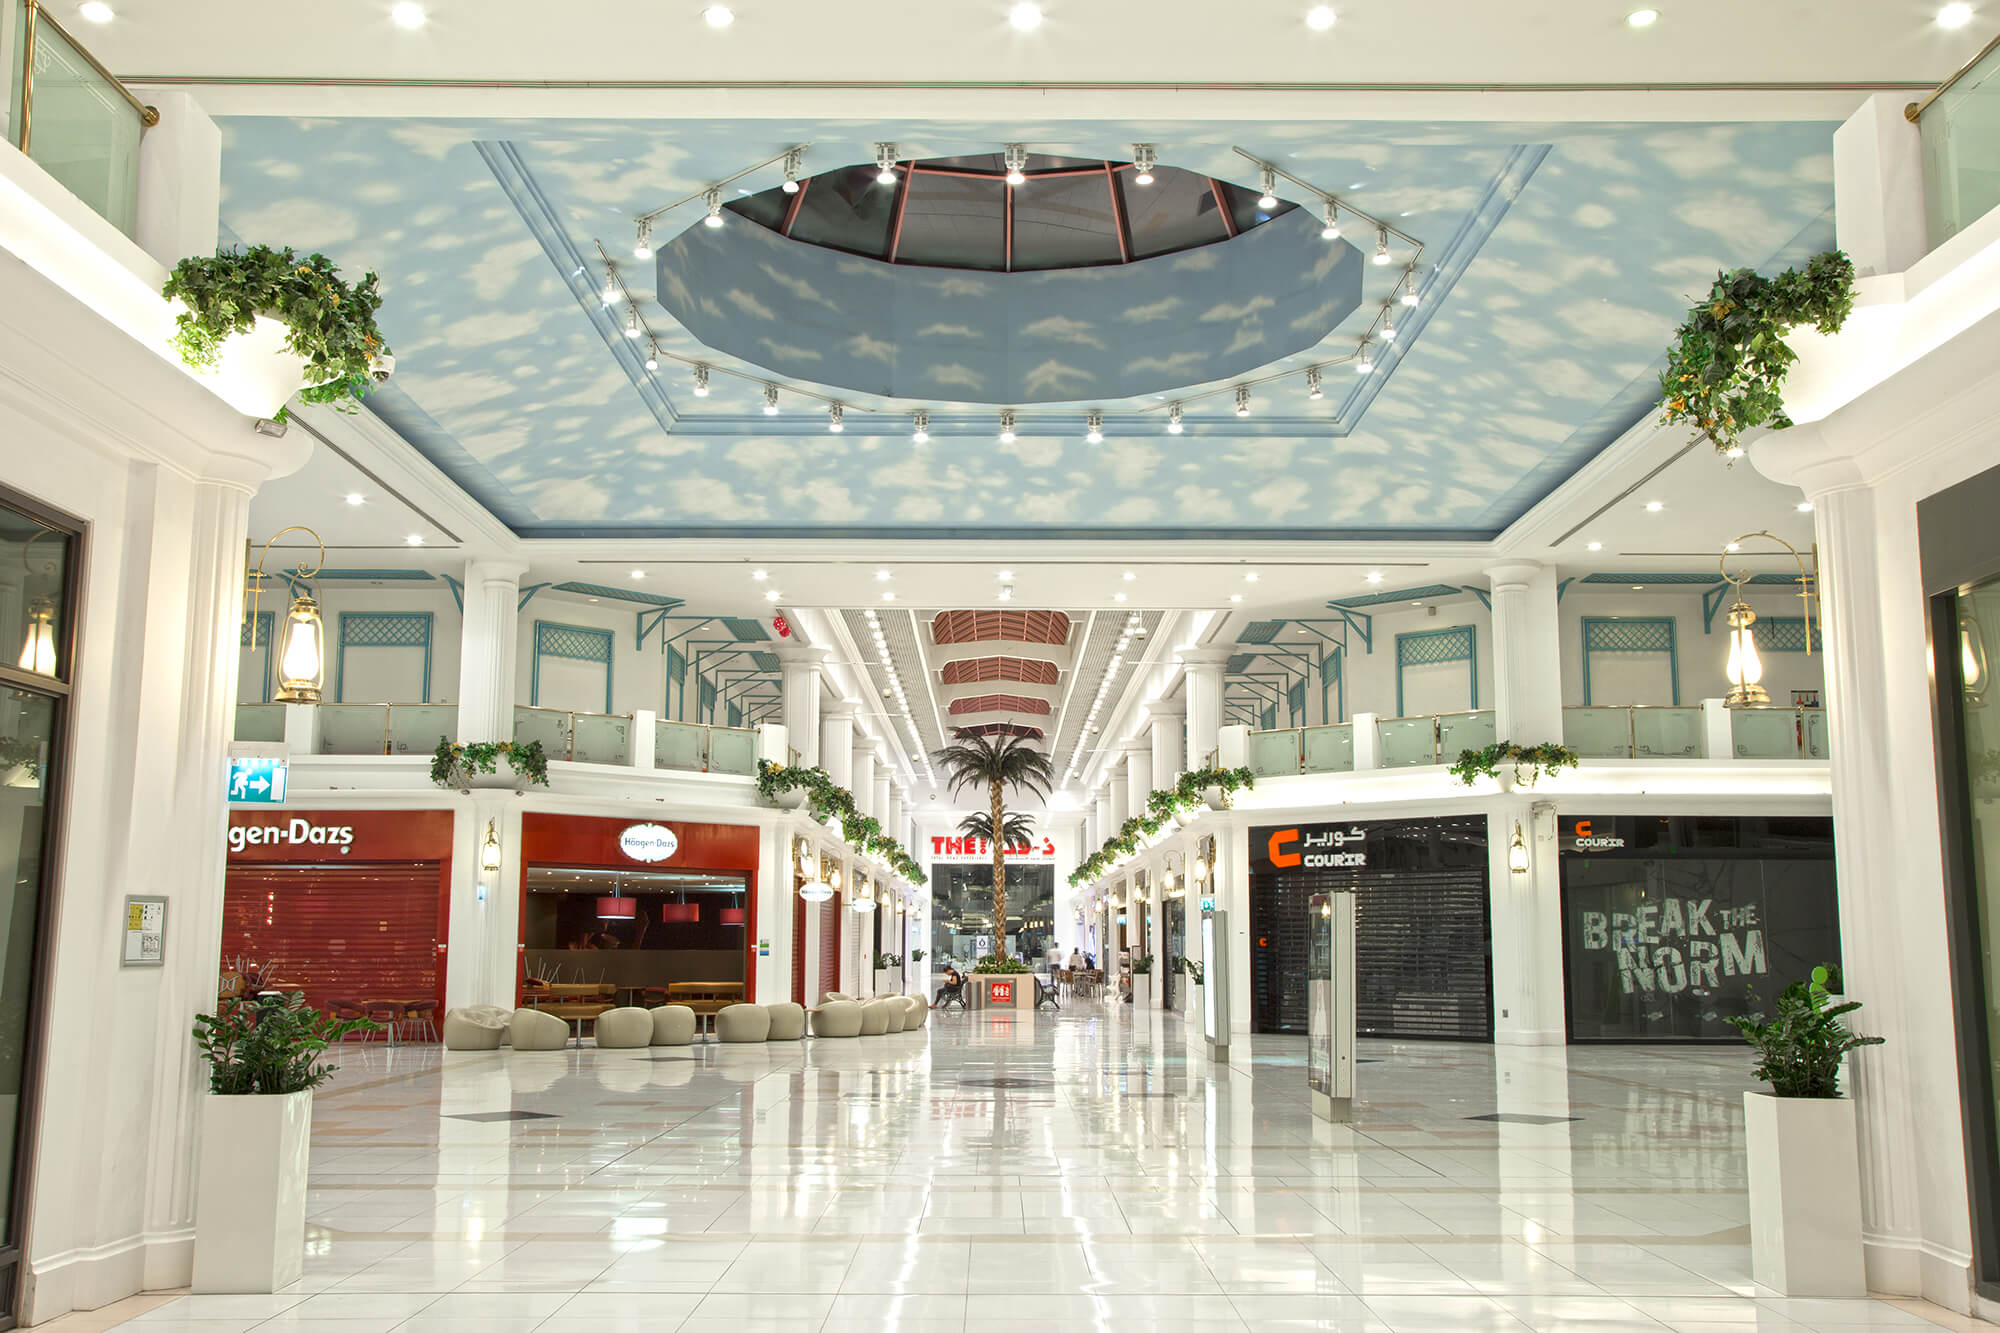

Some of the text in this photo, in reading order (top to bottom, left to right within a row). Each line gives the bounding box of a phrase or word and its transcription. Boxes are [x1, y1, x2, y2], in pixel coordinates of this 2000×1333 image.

[931, 836, 976, 855] THE
[1303, 826, 1369, 848] كورير
[1575, 836, 1624, 849] COURIR
[1303, 851, 1367, 867] COURIR
[1583, 898, 1760, 952] BREAK THE
[1616, 930, 1767, 994] NORM
